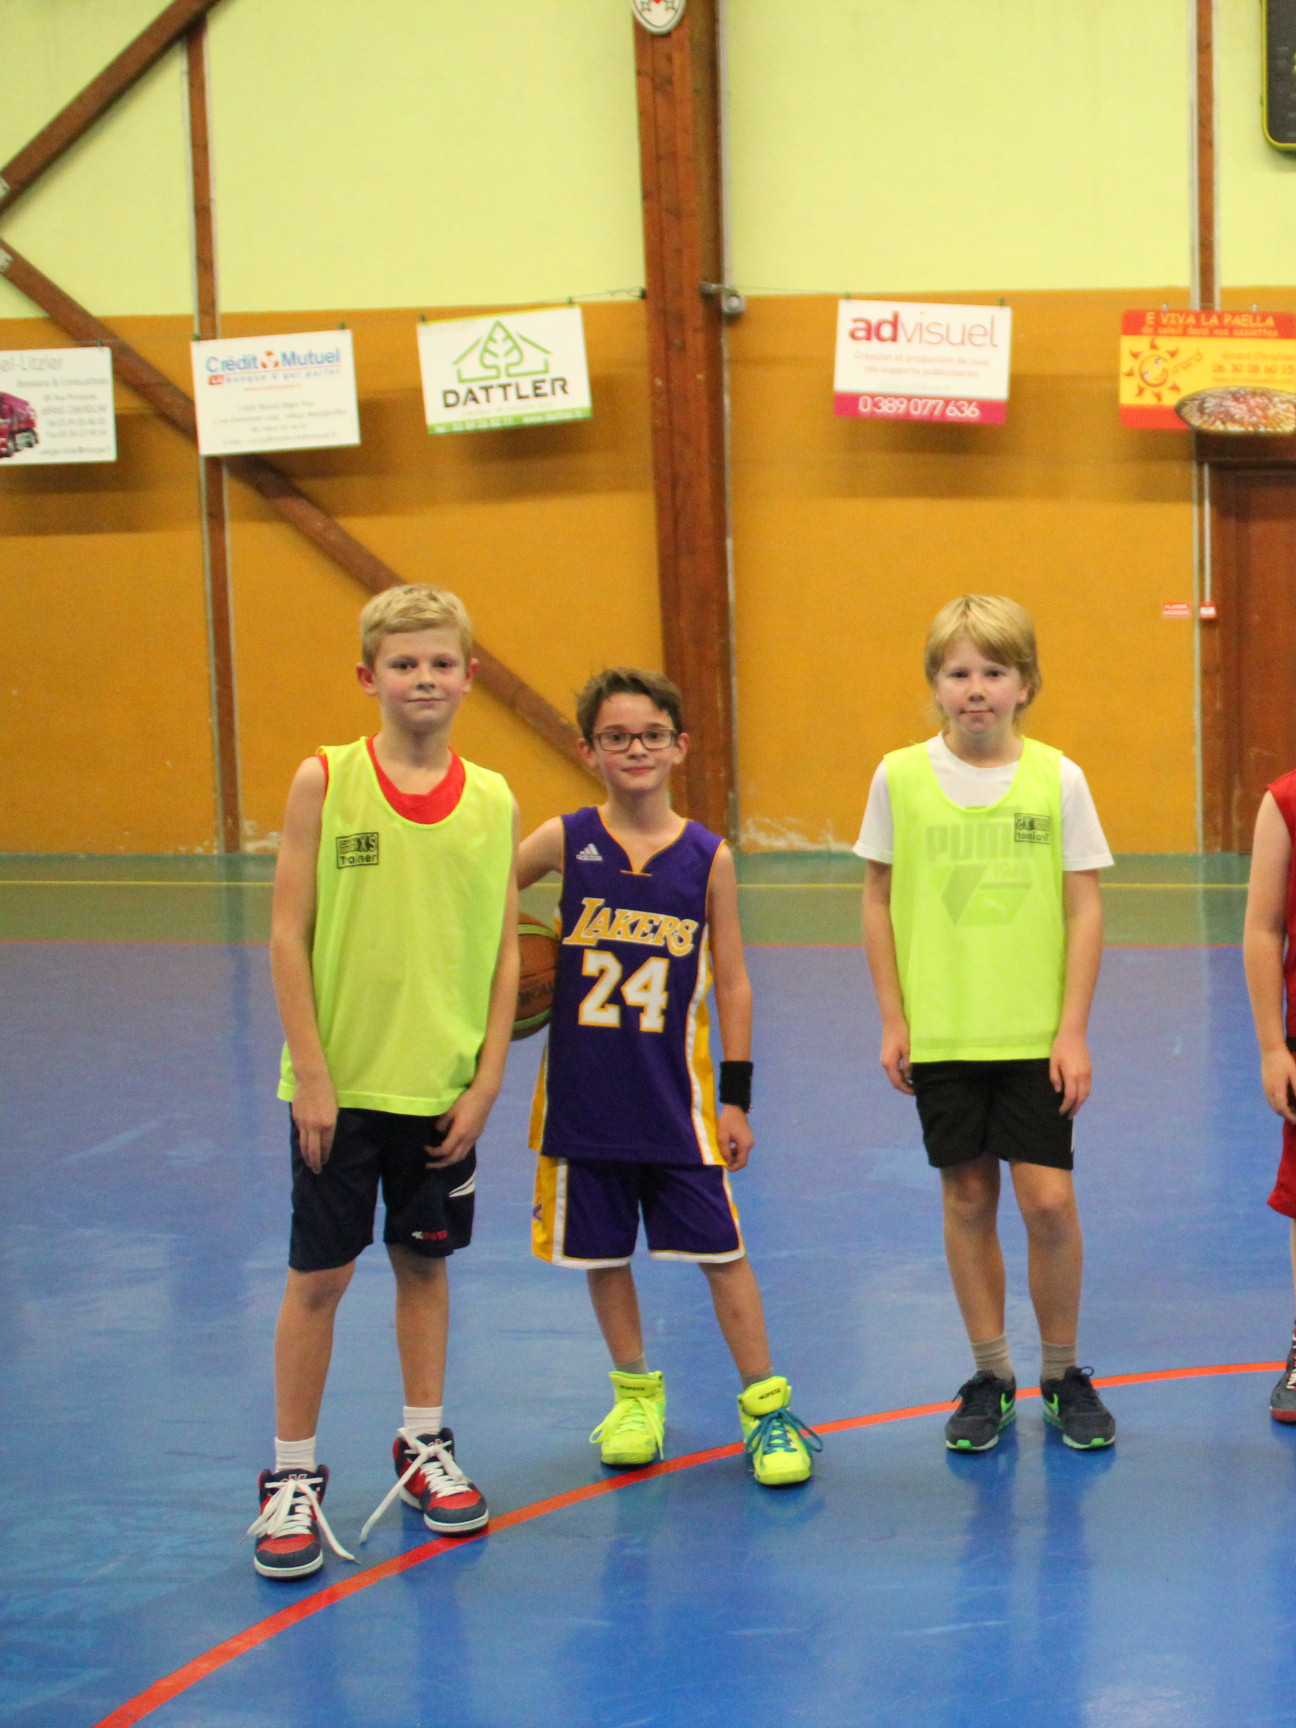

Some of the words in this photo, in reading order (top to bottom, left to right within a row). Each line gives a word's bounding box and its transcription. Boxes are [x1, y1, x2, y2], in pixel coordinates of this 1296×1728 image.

[849, 310, 998, 347] advisuel
[1146, 312, 1156, 324] E
[1161, 312, 1196, 325] VIVA
[1201, 313, 1218, 325] LA
[1224, 313, 1275, 327] PAELLA
[206, 354, 258, 373] Crédit
[281, 348, 340, 367] Mutuel
[443, 377, 568, 408] DATTLER
[874, 397, 907, 414] 389
[910, 399, 944, 416] 077
[946, 400, 981, 418] 636
[562, 897, 699, 957] LAKERS
[578, 949, 670, 1034] 24
